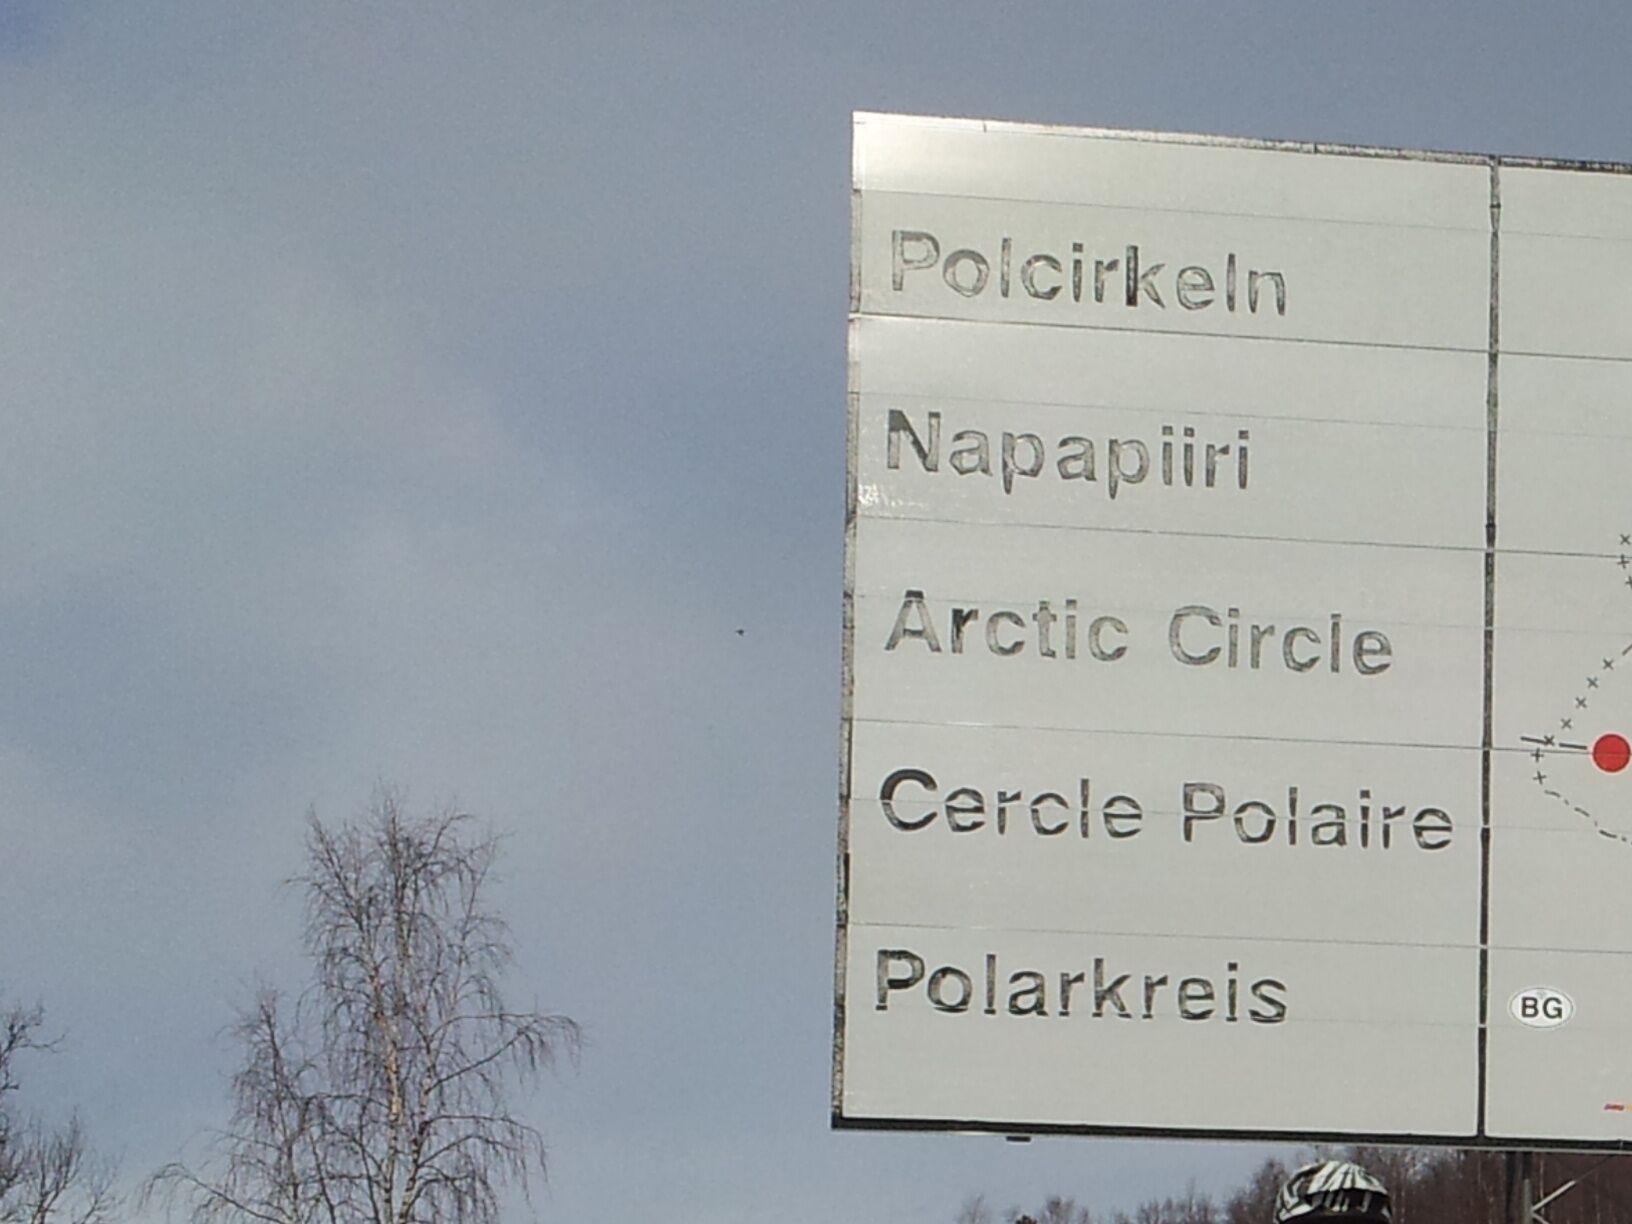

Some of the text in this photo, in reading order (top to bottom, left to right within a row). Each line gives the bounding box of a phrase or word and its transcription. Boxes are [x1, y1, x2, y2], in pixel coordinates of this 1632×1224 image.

[891, 229, 1287, 317] Polcirkeln
[886, 408, 1251, 500] Napapiiri
[884, 589, 1394, 676] Arctic Circle
[879, 767, 1454, 851] Cercle Polaire
[875, 948, 1288, 1024] Polarkreis
[1521, 996, 1563, 1019] BG
